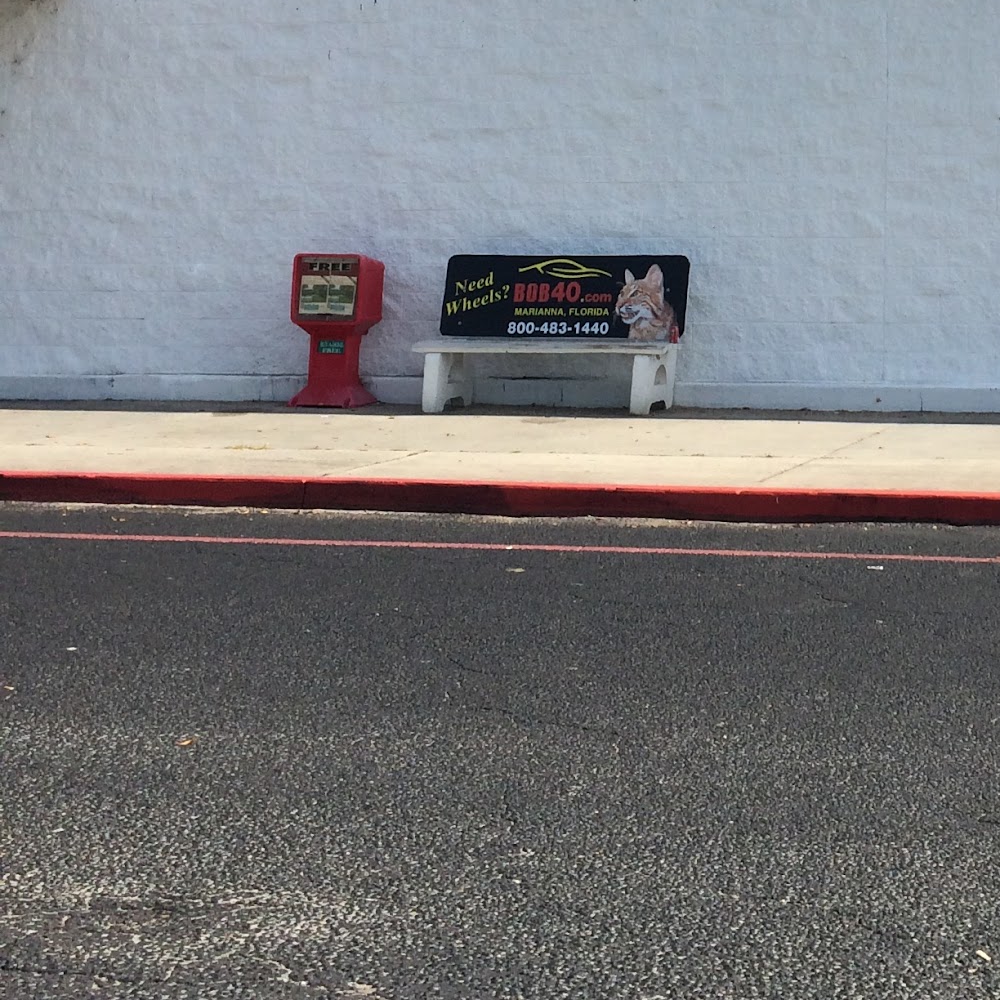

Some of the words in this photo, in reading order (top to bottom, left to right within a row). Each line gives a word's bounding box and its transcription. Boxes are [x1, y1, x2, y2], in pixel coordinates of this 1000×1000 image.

[308, 262, 352, 271] FREE
[455, 271, 494, 296] Need
[513, 281, 612, 302] BOB40.com
[446, 284, 510, 316] Wheels?
[514, 307, 567, 317] MARIANNA,
[569, 307, 610, 316] FLORIDA
[507, 321, 610, 335] 800-483-1440
